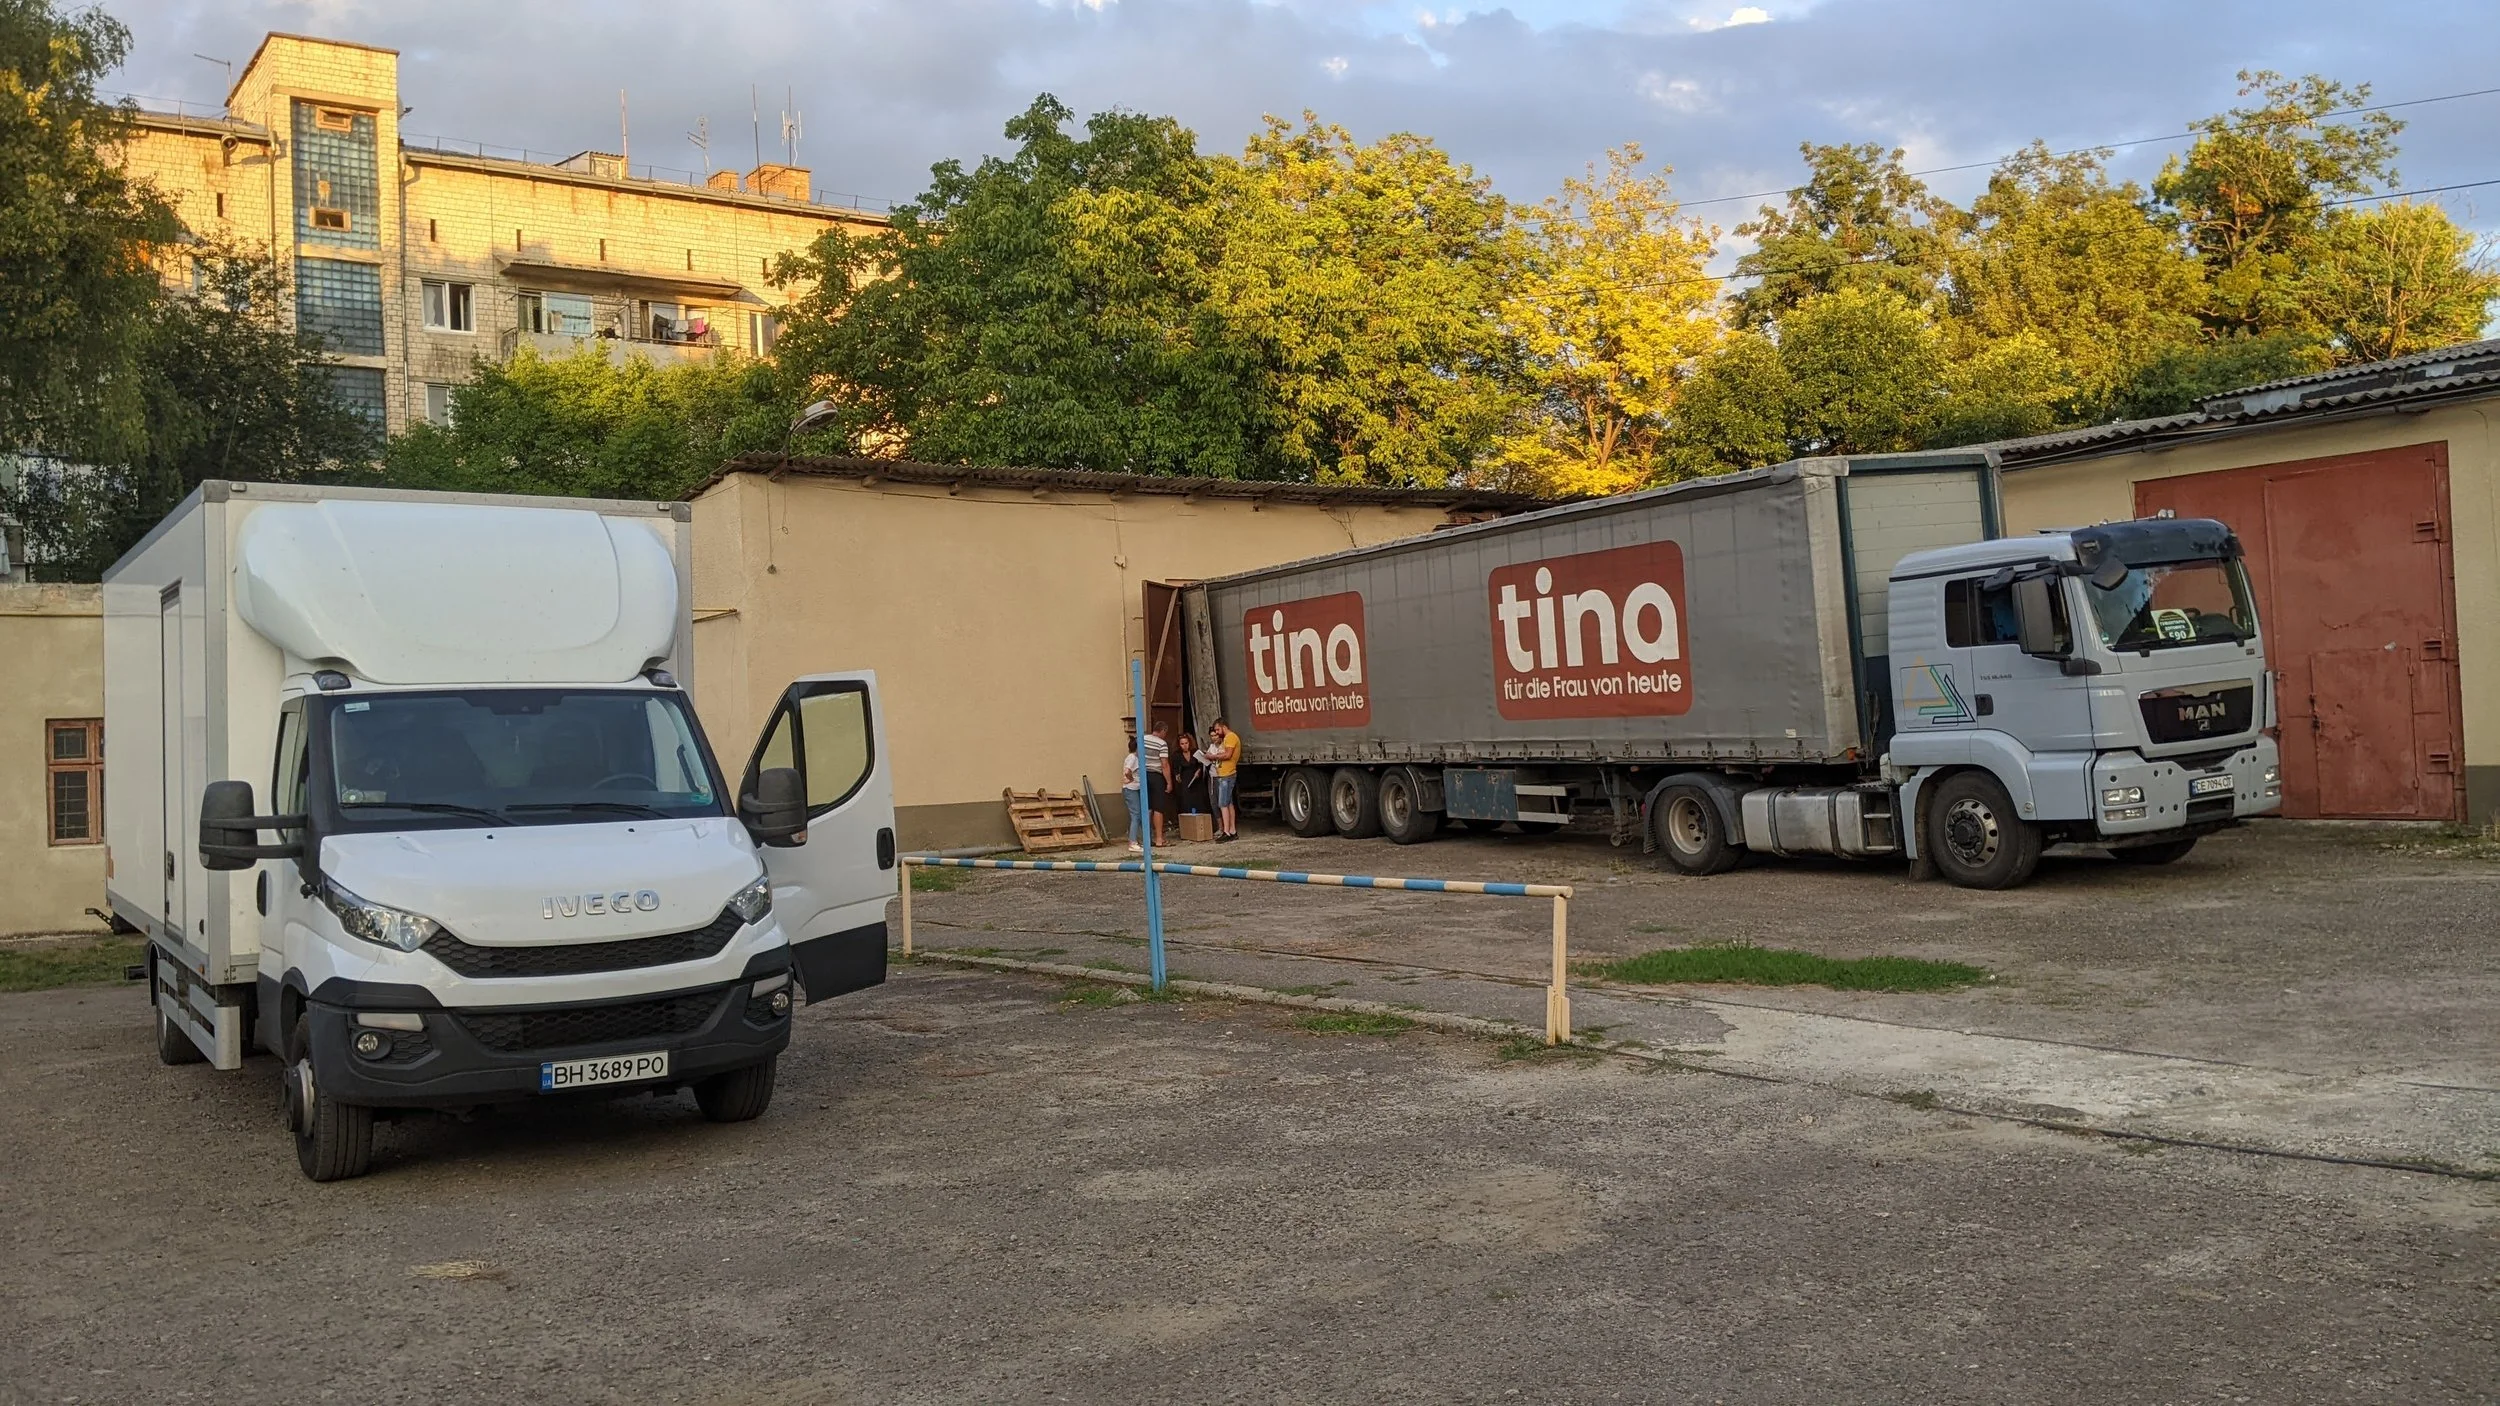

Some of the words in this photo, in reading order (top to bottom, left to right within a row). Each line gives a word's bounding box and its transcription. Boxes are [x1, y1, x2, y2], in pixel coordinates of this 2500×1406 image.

[1497, 566, 1681, 674] tina
[1249, 609, 1363, 694] tina
[1504, 677, 1524, 700] für
[1525, 677, 1551, 699] die
[1553, 675, 1588, 698] Frau
[1590, 676, 1623, 696] von
[1627, 669, 1682, 694] heute
[1254, 698, 1267, 715] für
[1268, 697, 1284, 714] die
[1285, 695, 1308, 713] Frau
[1308, 697, 1328, 712] von
[1330, 691, 1364, 710] heute
[2177, 702, 2226, 721] MAN
[540, 889, 660, 919] IVECO
[542, 1079, 552, 1087] UA
[554, 1064, 584, 1085] BH
[588, 1060, 633, 1081] 3689
[636, 1056, 664, 1076] PO
